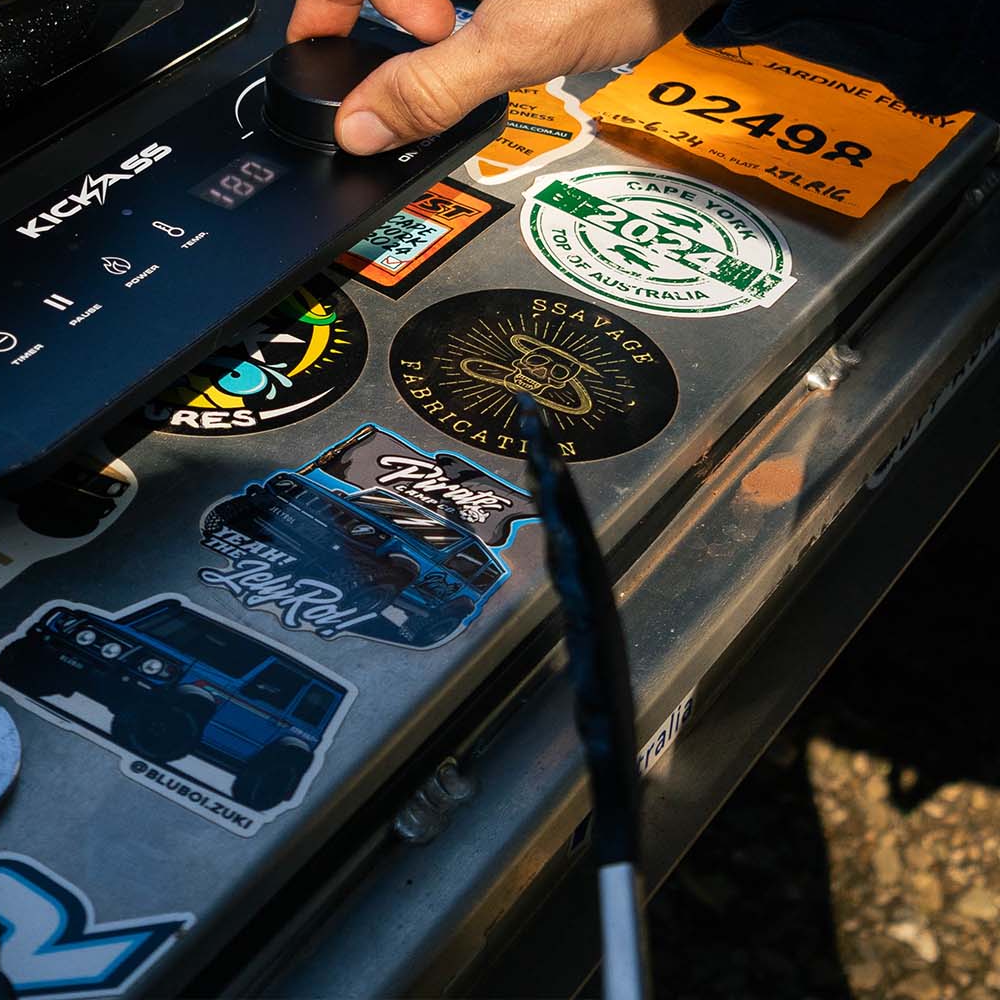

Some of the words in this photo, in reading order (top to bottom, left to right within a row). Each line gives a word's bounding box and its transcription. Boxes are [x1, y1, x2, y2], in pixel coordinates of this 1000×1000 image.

[764, 62, 872, 99] JARDINE
[508, 101, 537, 112] NCY
[508, 109, 555, 122] DNESS
[647, 81, 875, 170] 02498
[16, 142, 172, 239] KICKASS
[209, 161, 275, 205] 180
[387, 215, 437, 237] CAPE
[626, 181, 697, 202] CAPE
[706, 199, 758, 242] YORK
[181, 231, 209, 249] TEMP.
[584, 204, 724, 274] 2024
[125, 264, 160, 288] POWER
[551, 229, 572, 253] TOP
[567, 255, 592, 271] OF
[590, 271, 710, 301] AUSTRALIA
[69, 303, 103, 326] PAUSE
[532, 298, 656, 366] SSAVAGE
[11, 343, 44, 366] TIMER
[400, 359, 578, 457] FABRICATIN
[395, 485, 438, 504] CAMP
[206, 537, 248, 560] THE
[213, 525, 298, 566] YEAH!
